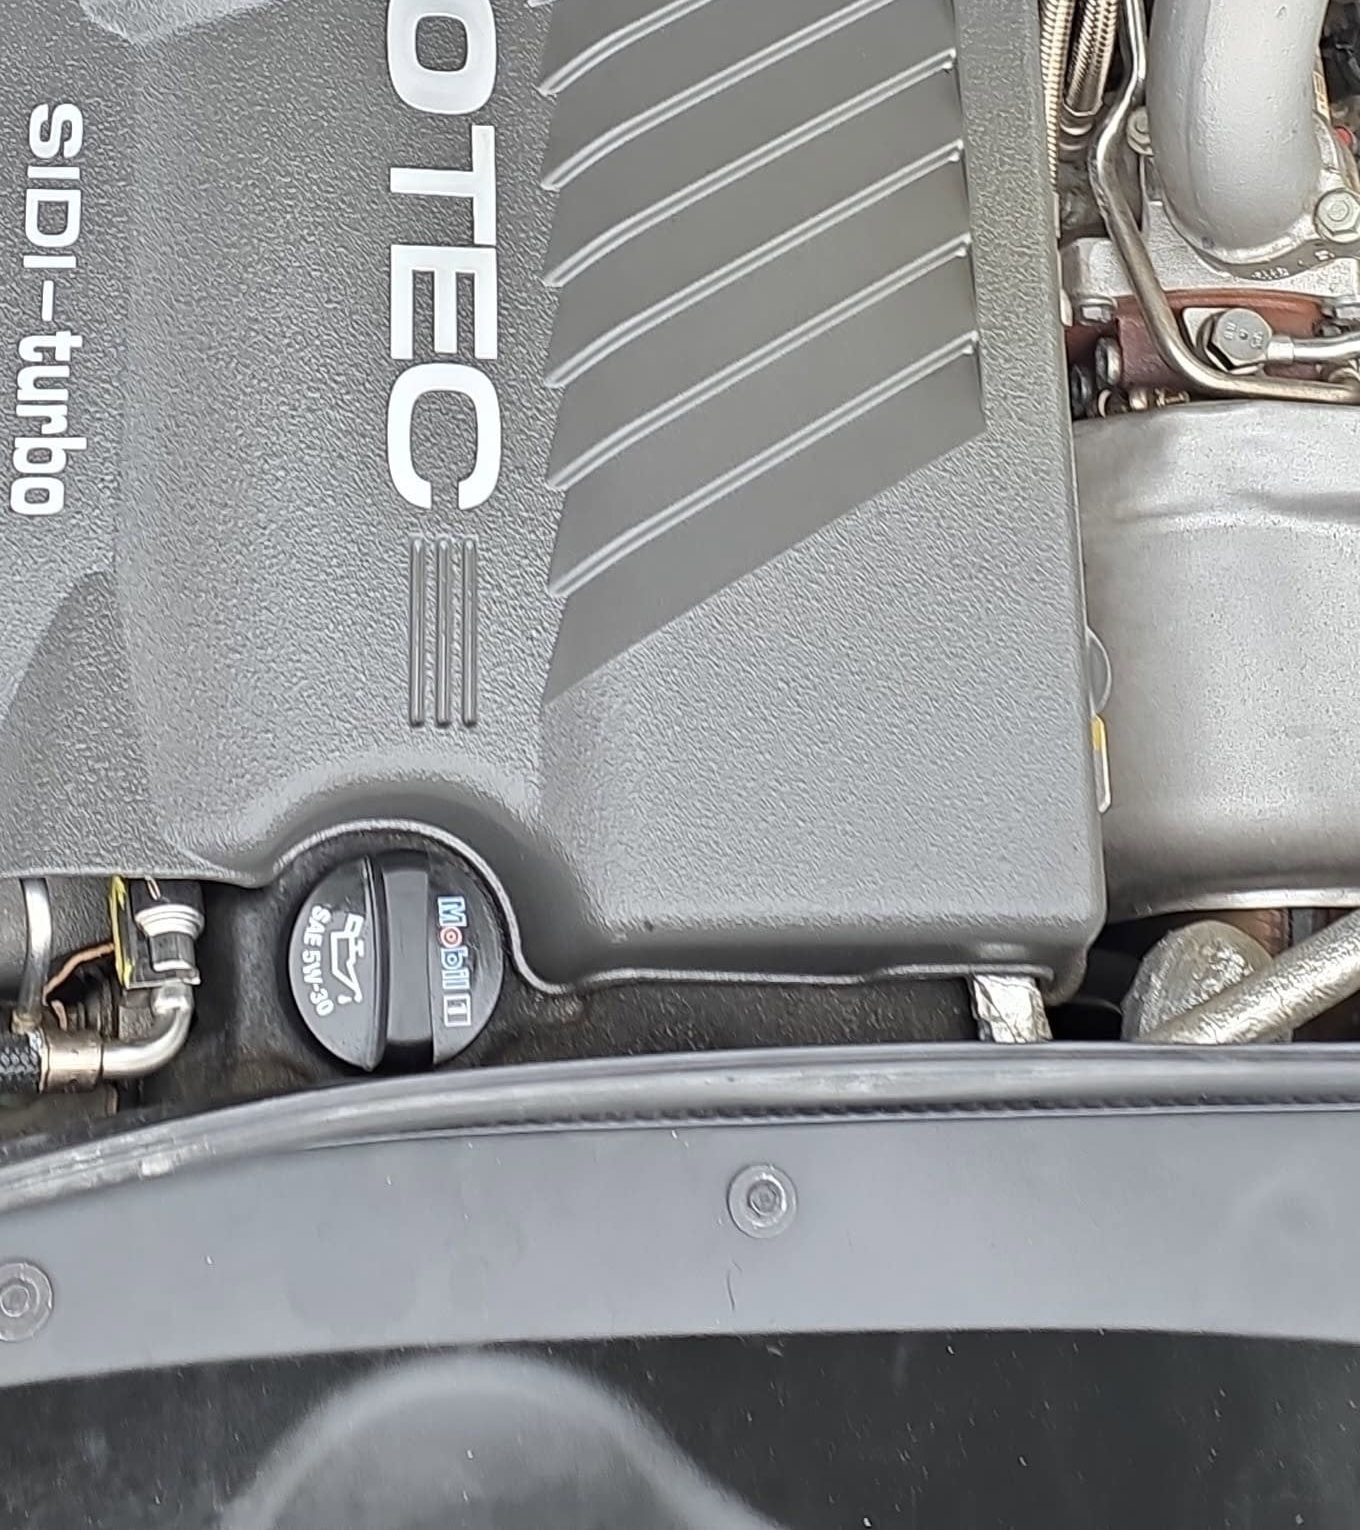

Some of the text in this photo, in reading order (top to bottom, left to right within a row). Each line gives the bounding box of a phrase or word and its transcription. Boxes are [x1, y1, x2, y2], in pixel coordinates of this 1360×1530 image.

[10, 103, 88, 516] SIDI-turbo
[301, 905, 335, 1017] SAE 5W-30
[437, 896, 470, 990] Mobil
